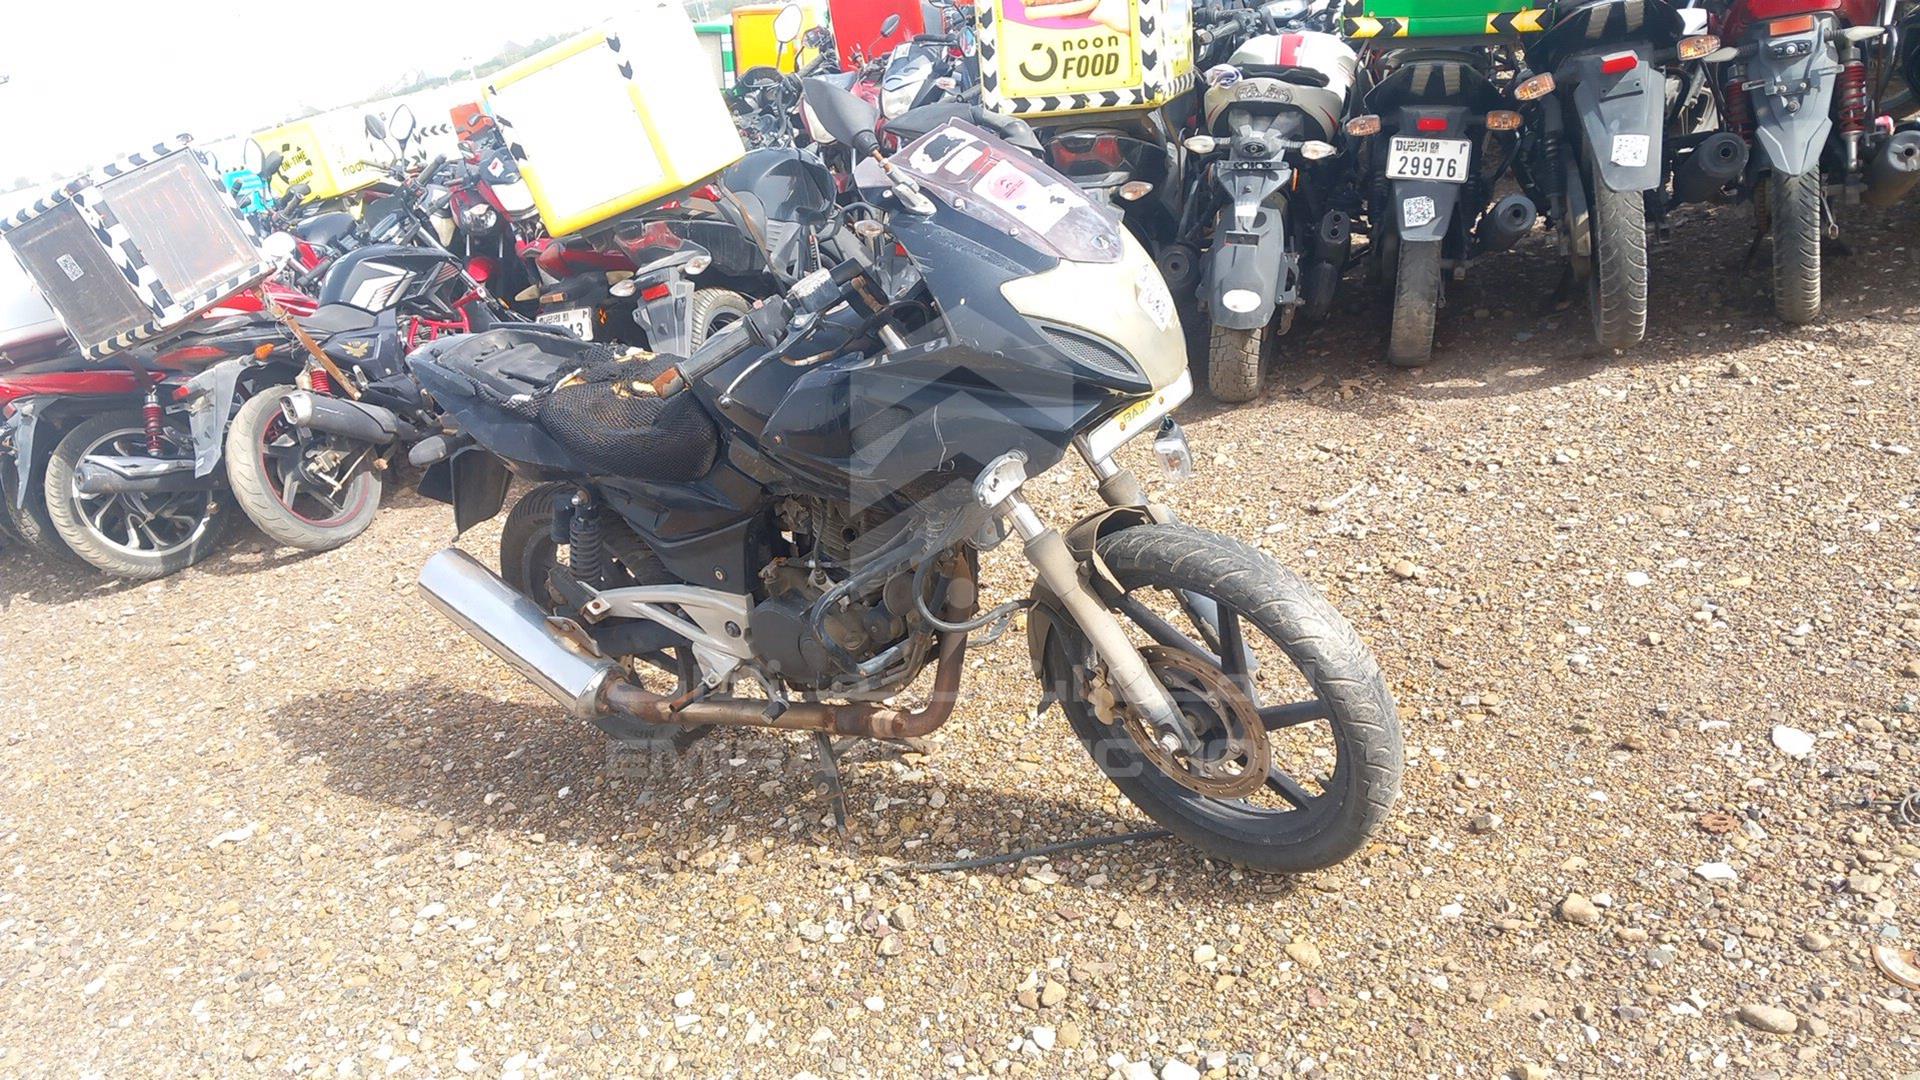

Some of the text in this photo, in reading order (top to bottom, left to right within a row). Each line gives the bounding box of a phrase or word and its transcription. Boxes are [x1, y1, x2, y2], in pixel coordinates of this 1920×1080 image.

[1062, 35, 1119, 51] noon
[1062, 52, 1119, 79] FOOD
[1397, 155, 1457, 178] 29976
